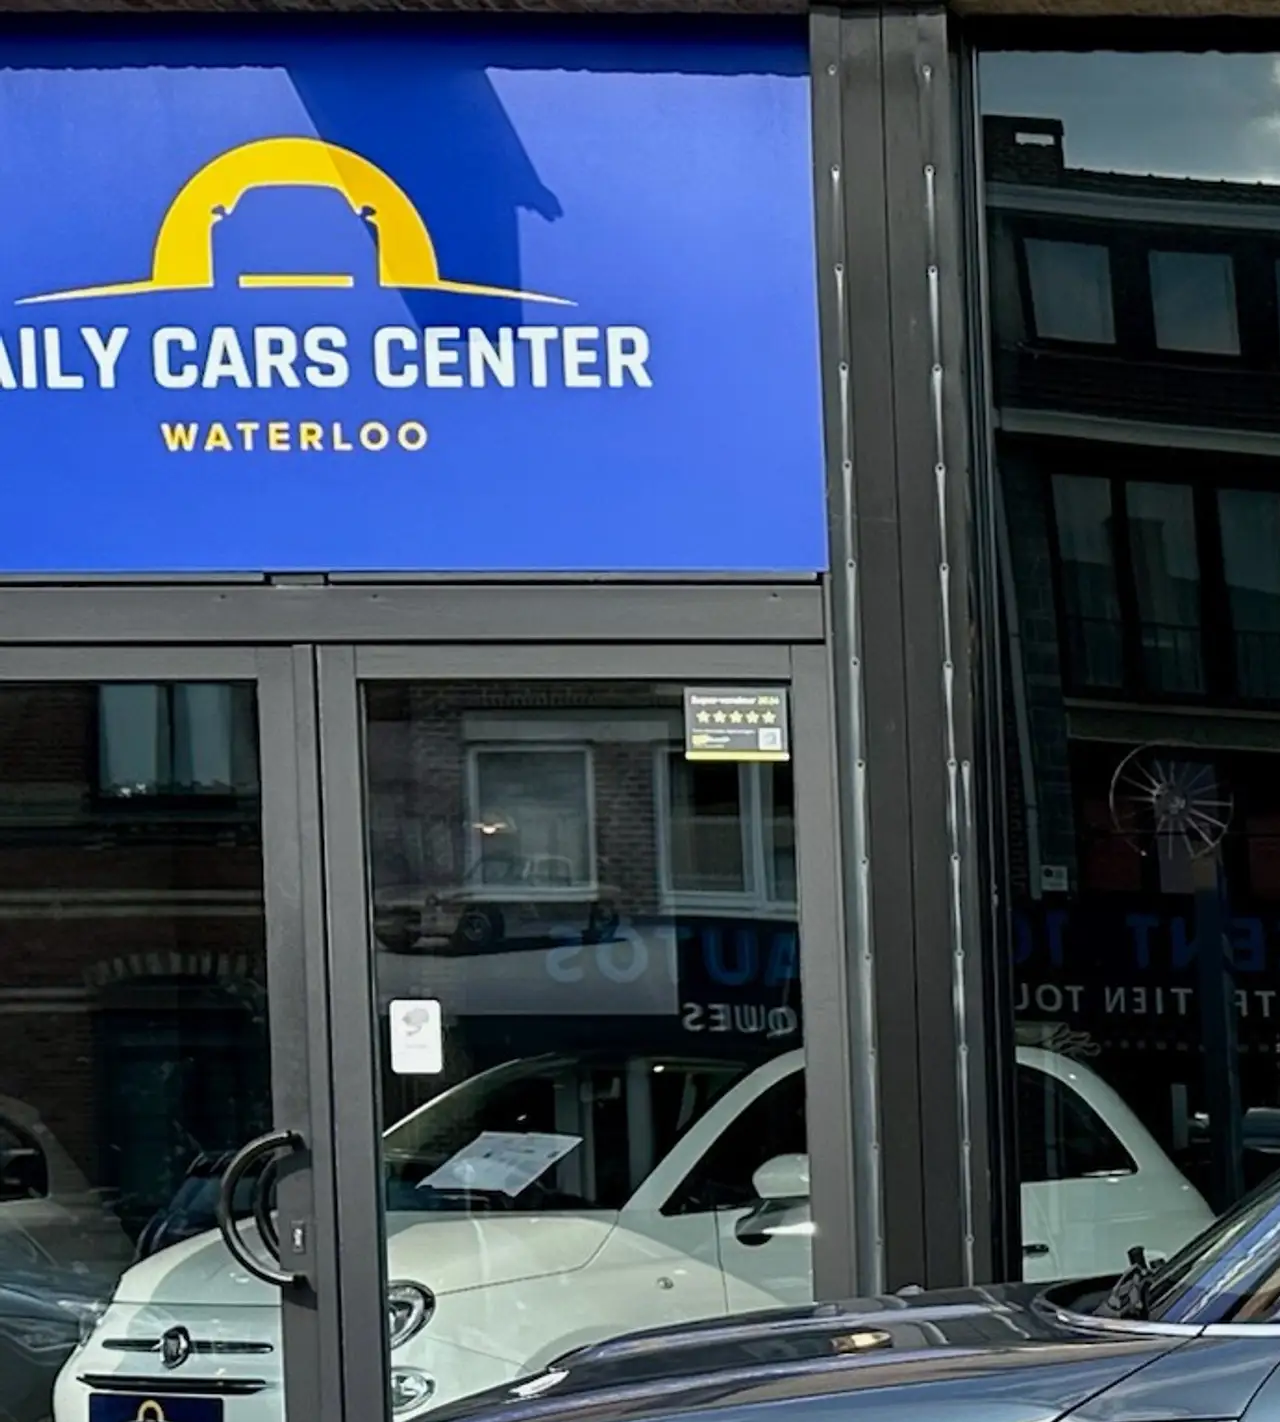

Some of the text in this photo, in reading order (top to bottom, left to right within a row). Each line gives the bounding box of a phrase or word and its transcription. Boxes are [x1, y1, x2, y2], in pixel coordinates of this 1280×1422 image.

[152, 326, 350, 389] CARS
[373, 326, 653, 388] CENTER
[161, 421, 429, 452] WATERLOO
